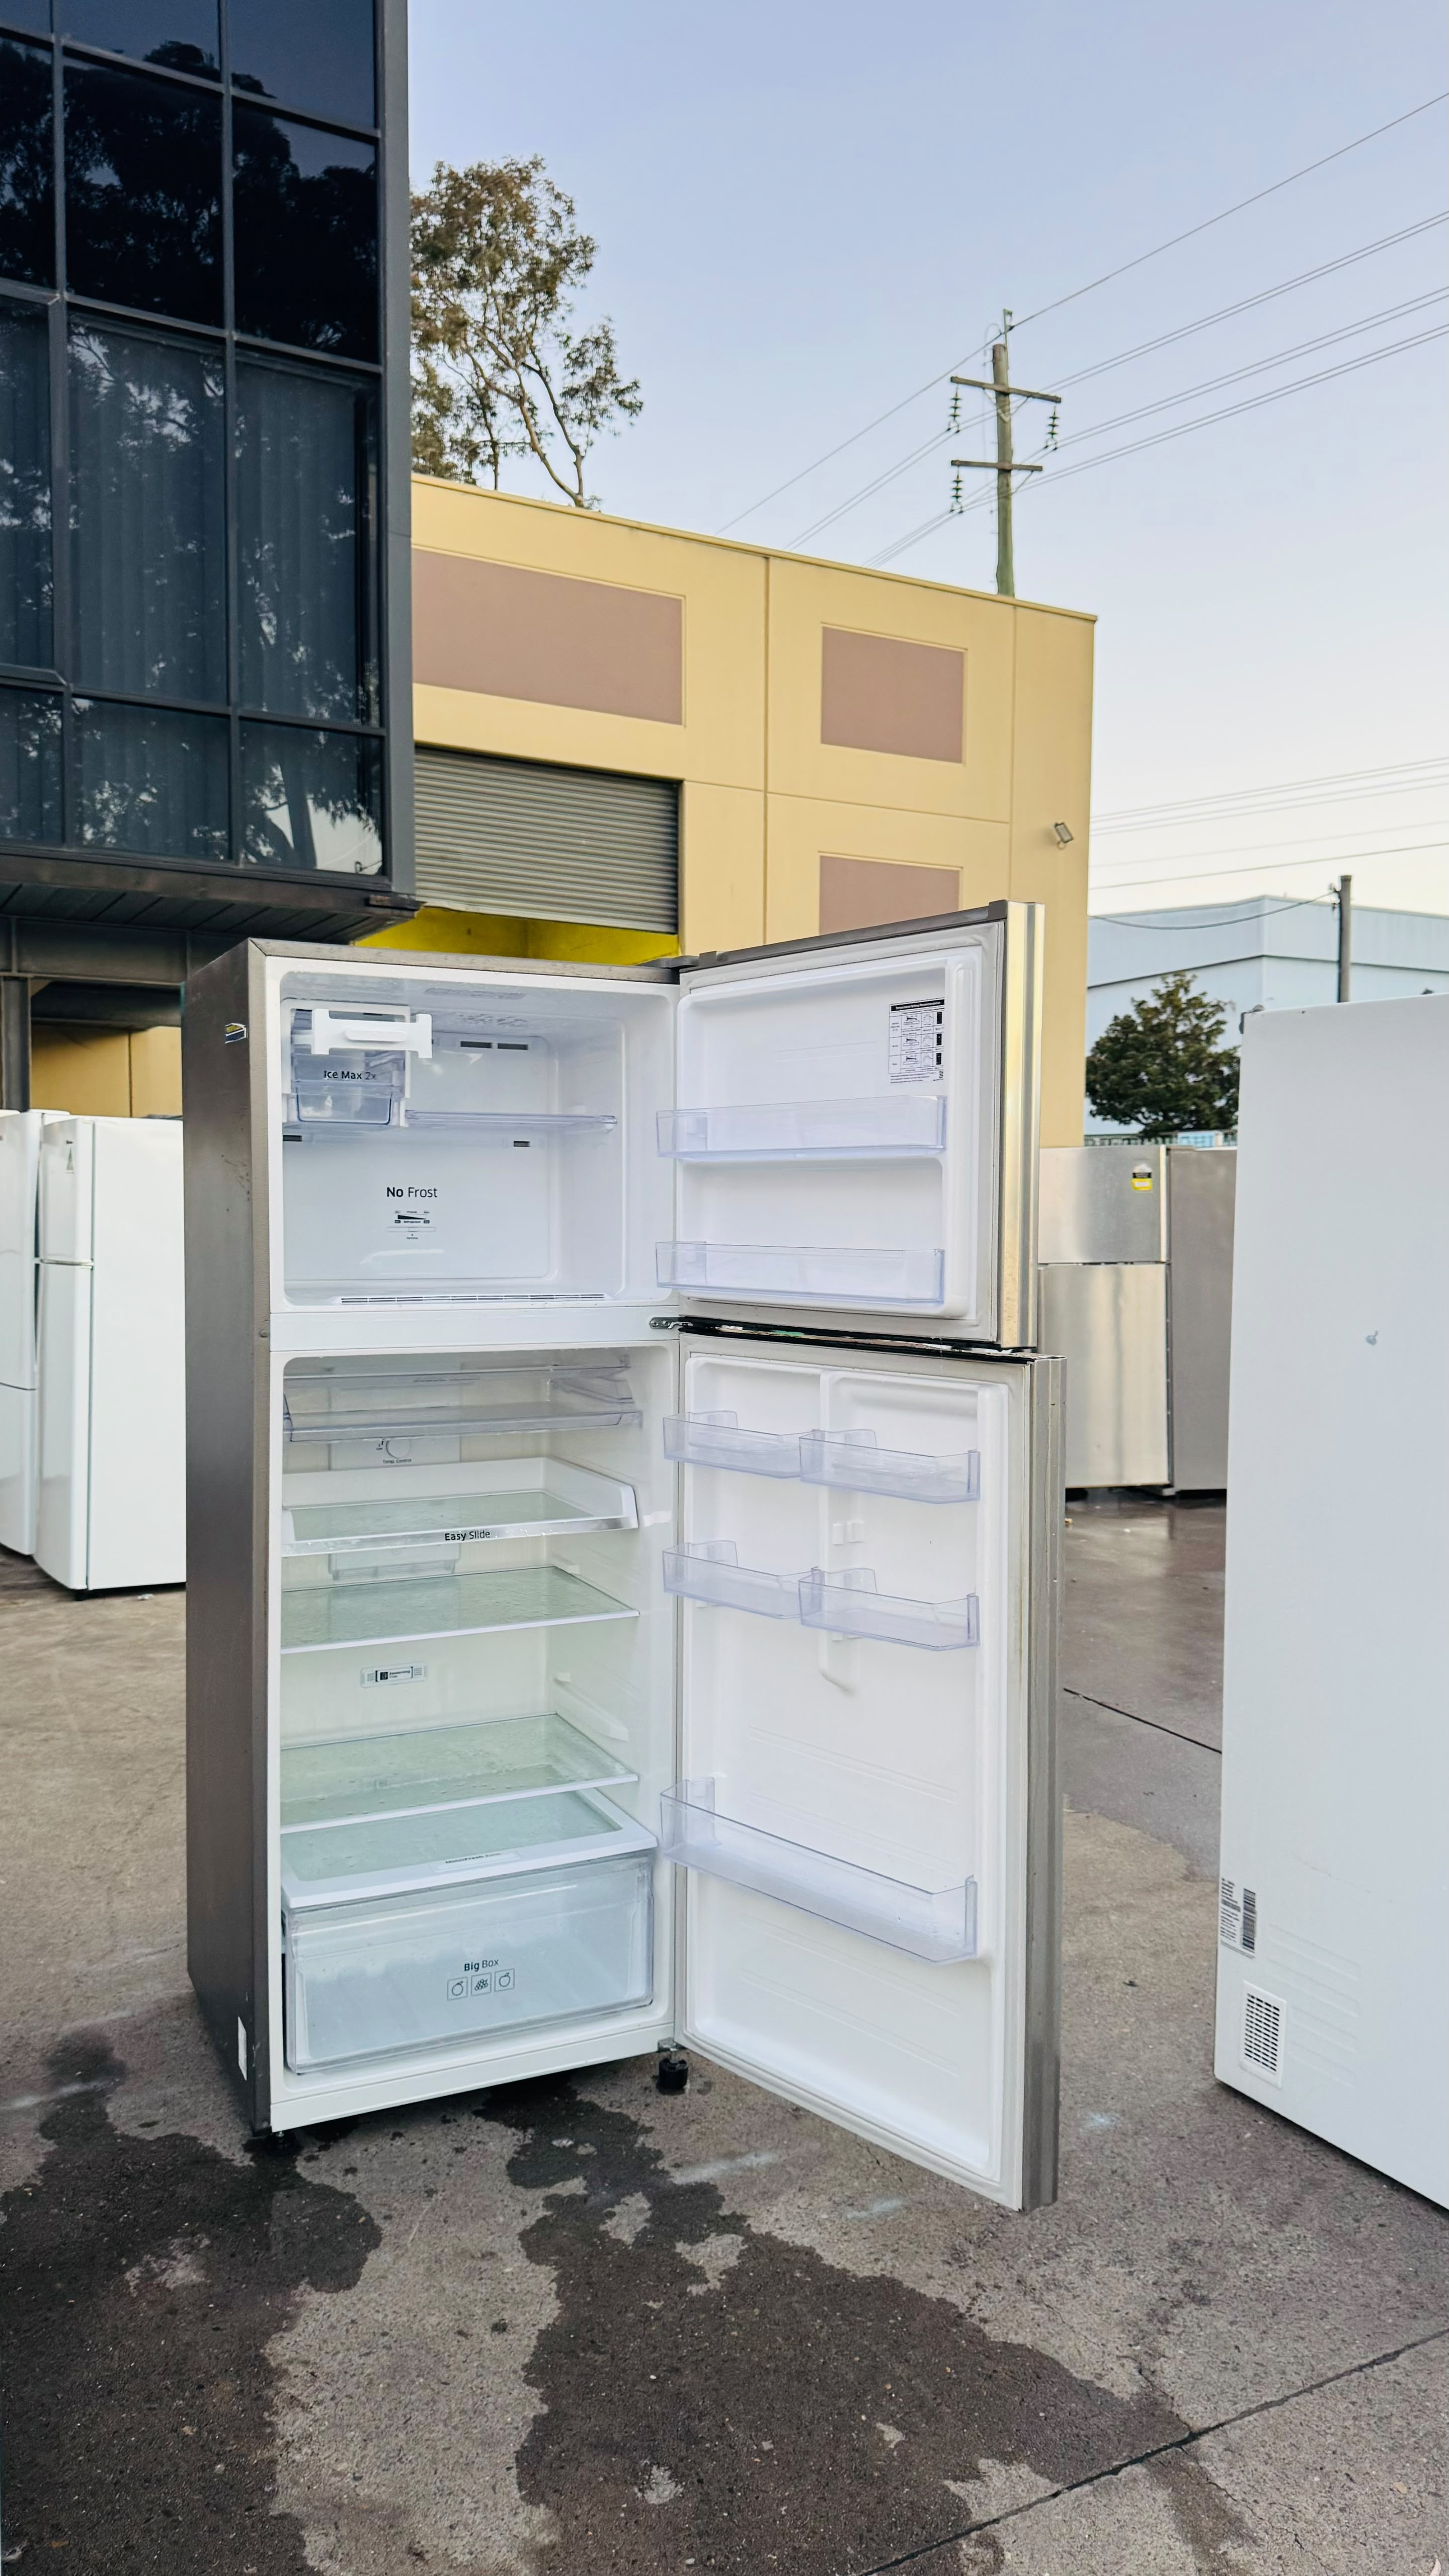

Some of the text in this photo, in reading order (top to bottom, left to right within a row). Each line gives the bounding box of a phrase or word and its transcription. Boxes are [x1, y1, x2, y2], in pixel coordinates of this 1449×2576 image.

[324, 1070, 377, 1080] Ice Max 2x
[386, 1187, 438, 1198] No Frost
[469, 1530, 490, 1539] Slide
[464, 1959, 499, 1972] Big Box
